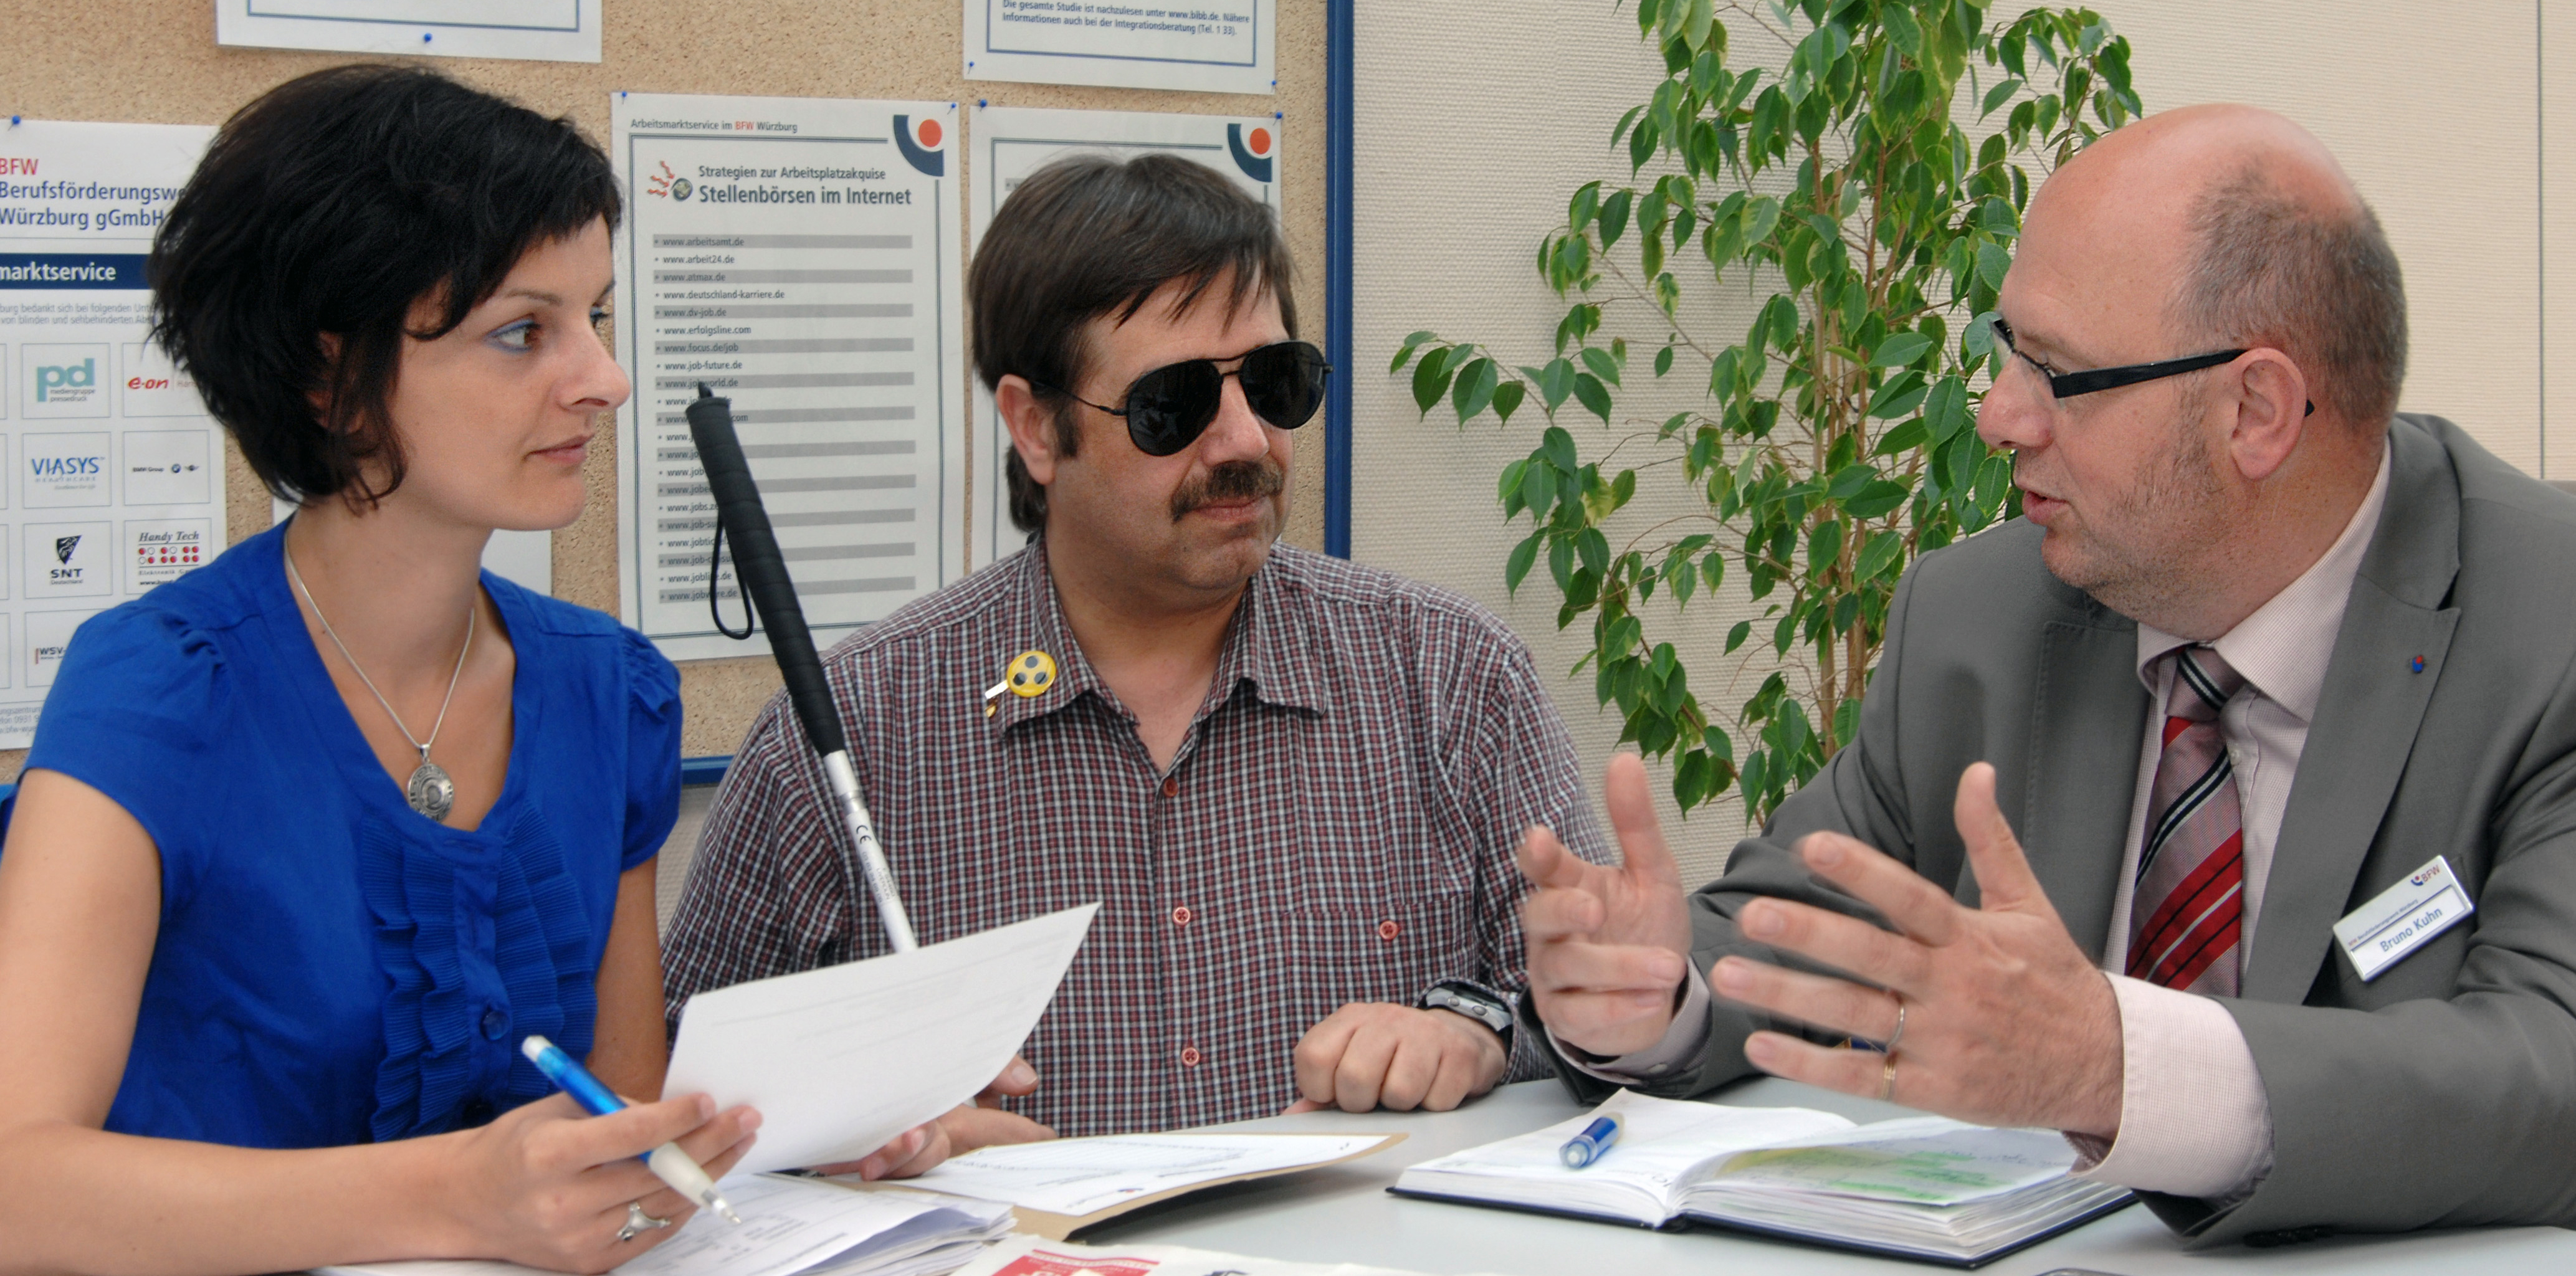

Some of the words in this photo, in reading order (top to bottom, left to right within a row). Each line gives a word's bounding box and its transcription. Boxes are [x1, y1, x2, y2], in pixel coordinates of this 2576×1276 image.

[1003, 0, 1016, 8] Die
[1020, 1, 1054, 11] gesamte
[1057, 2, 1082, 12] Studie
[1085, 4, 1094, 12] ist
[1097, 5, 1143, 16] nachzulesen
[1146, 9, 1166, 17] unter
[1223, 12, 1250, 22] Nähere
[1002, 12, 1061, 24] Informationen
[1064, 16, 1082, 25] auch
[1085, 17, 1097, 26] bei
[1100, 18, 1112, 27] der
[1115, 19, 1196, 34] Integrationsberatung
[1198, 24, 1214, 35] (Tel.
[631, 118, 719, 130] Arbeitsmarktservice
[722, 120, 732, 130] im
[735, 121, 754, 130] BFW
[757, 122, 798, 133] Würzburg
[0, 158, 39, 175] BFW
[699, 165, 757, 180] Strategien
[761, 168, 777, 178] zur
[780, 166, 886, 182] Arbeitsplatzakquise
[700, 184, 816, 203] Stellenbörsen
[821, 186, 841, 204] im
[847, 187, 912, 204] Internet
[0, 207, 88, 231] Würzburg
[96, 209, 164, 231] gGmbH
[663, 237, 745, 247] www.arbeitsamt.de
[663, 255, 735, 264] www.arbeit24.de
[663, 272, 726, 281] www.atmax.de
[664, 290, 785, 299] www.deutschland-karriere.de
[22, 303, 55, 313] bedankt
[58, 303, 74, 313] sich
[75, 303, 88, 313] bei
[91, 303, 132, 315] folgenden
[664, 308, 727, 318] www.dv-job.de
[19, 314, 49, 324] blinden
[53, 315, 67, 325] und
[70, 314, 133, 325] sehbehinderten
[664, 325, 751, 336] www.erfolgsline.com
[664, 343, 739, 353] www.focus.de/job
[665, 361, 743, 372] www.job-future.de
[37, 358, 95, 402] pd
[665, 378, 739, 389] www.joworld.de
[31, 457, 100, 475] VIASYS
[139, 532, 173, 544] Handy
[176, 531, 199, 541] Tech
[50, 568, 83, 578] SNT
[2421, 865, 2441, 883] BFW
[2380, 927, 2413, 952] Bruno
[2413, 908, 2443, 930] Kuhn
